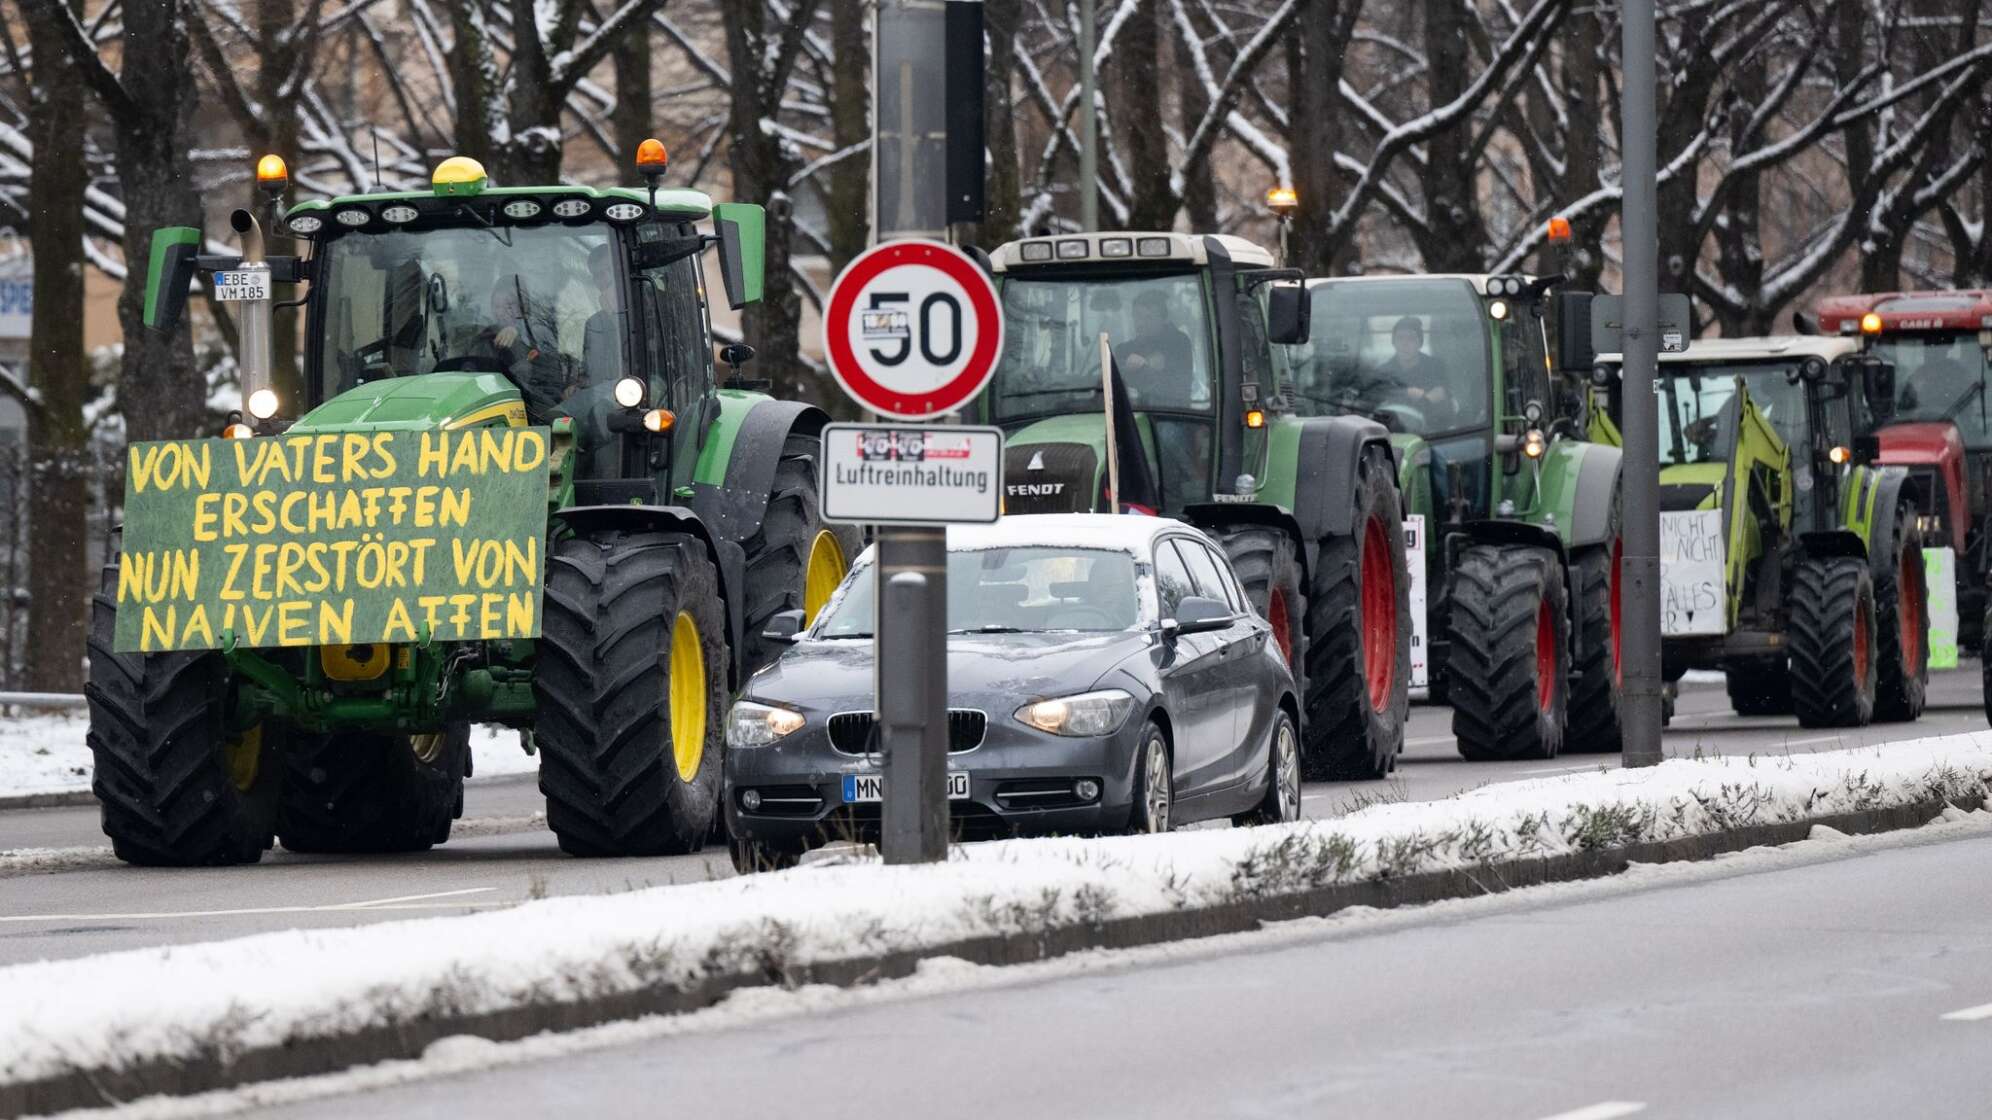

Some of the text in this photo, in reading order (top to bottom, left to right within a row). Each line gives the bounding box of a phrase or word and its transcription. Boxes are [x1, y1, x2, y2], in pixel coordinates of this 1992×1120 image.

[221, 286, 264, 299] VM 185
[224, 273, 249, 286] EBE
[869, 291, 962, 367] 50
[131, 430, 545, 493] VON VATERS HAND
[836, 463, 988, 493] Luftreinhaltung
[1007, 483, 1065, 496] FENDT
[194, 486, 471, 541] ERSCHAFFEN
[1662, 513, 1709, 537] NICHT
[117, 532, 537, 603] NUN ZERSTÖRT VON
[140, 591, 534, 653] NAIVEN AFFEN
[857, 778, 882, 798] MN
